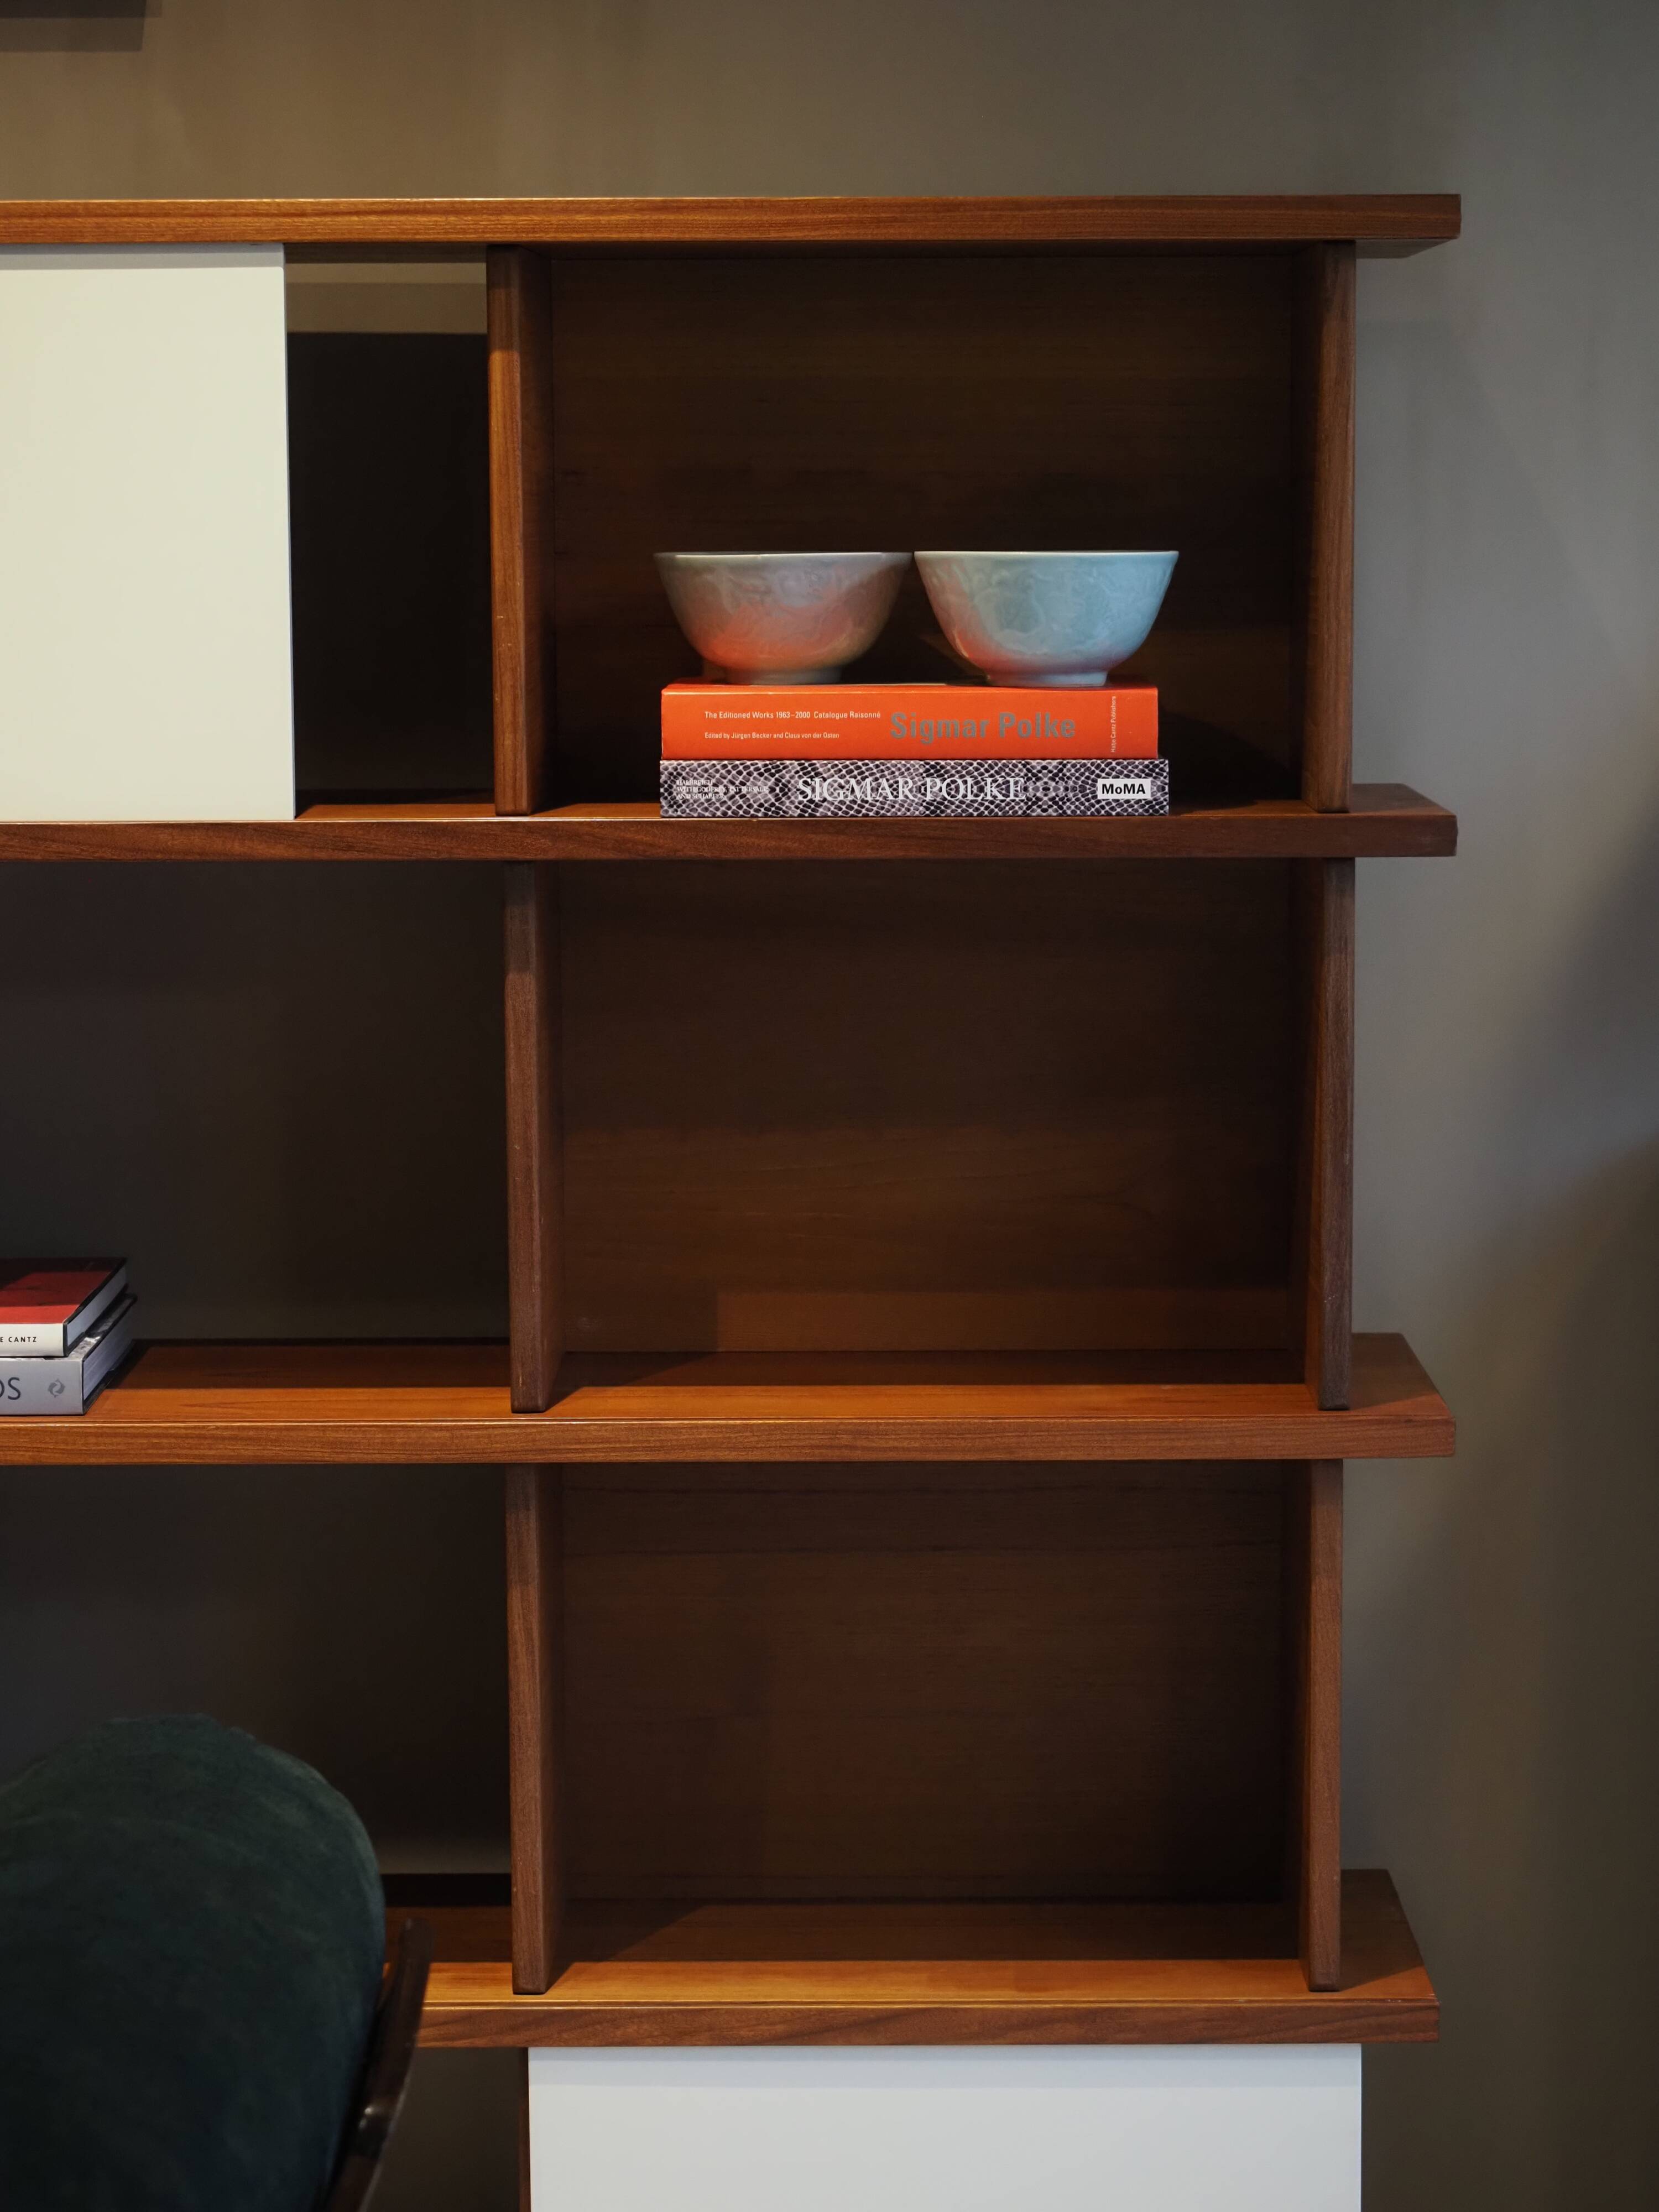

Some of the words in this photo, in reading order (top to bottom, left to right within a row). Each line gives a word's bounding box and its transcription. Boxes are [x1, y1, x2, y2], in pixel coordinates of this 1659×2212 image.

[813, 711, 848, 720] Catalogue
[723, 732, 730, 740] by
[731, 732, 751, 740] Jürgen
[890, 712, 990, 744] Sigmar
[999, 712, 1076, 738] Polke
[798, 777, 916, 801] SIGMAR
[925, 777, 1026, 801] POLKE
[1102, 783, 1146, 795] MoMA
[0, 1376, 21, 1401] S
